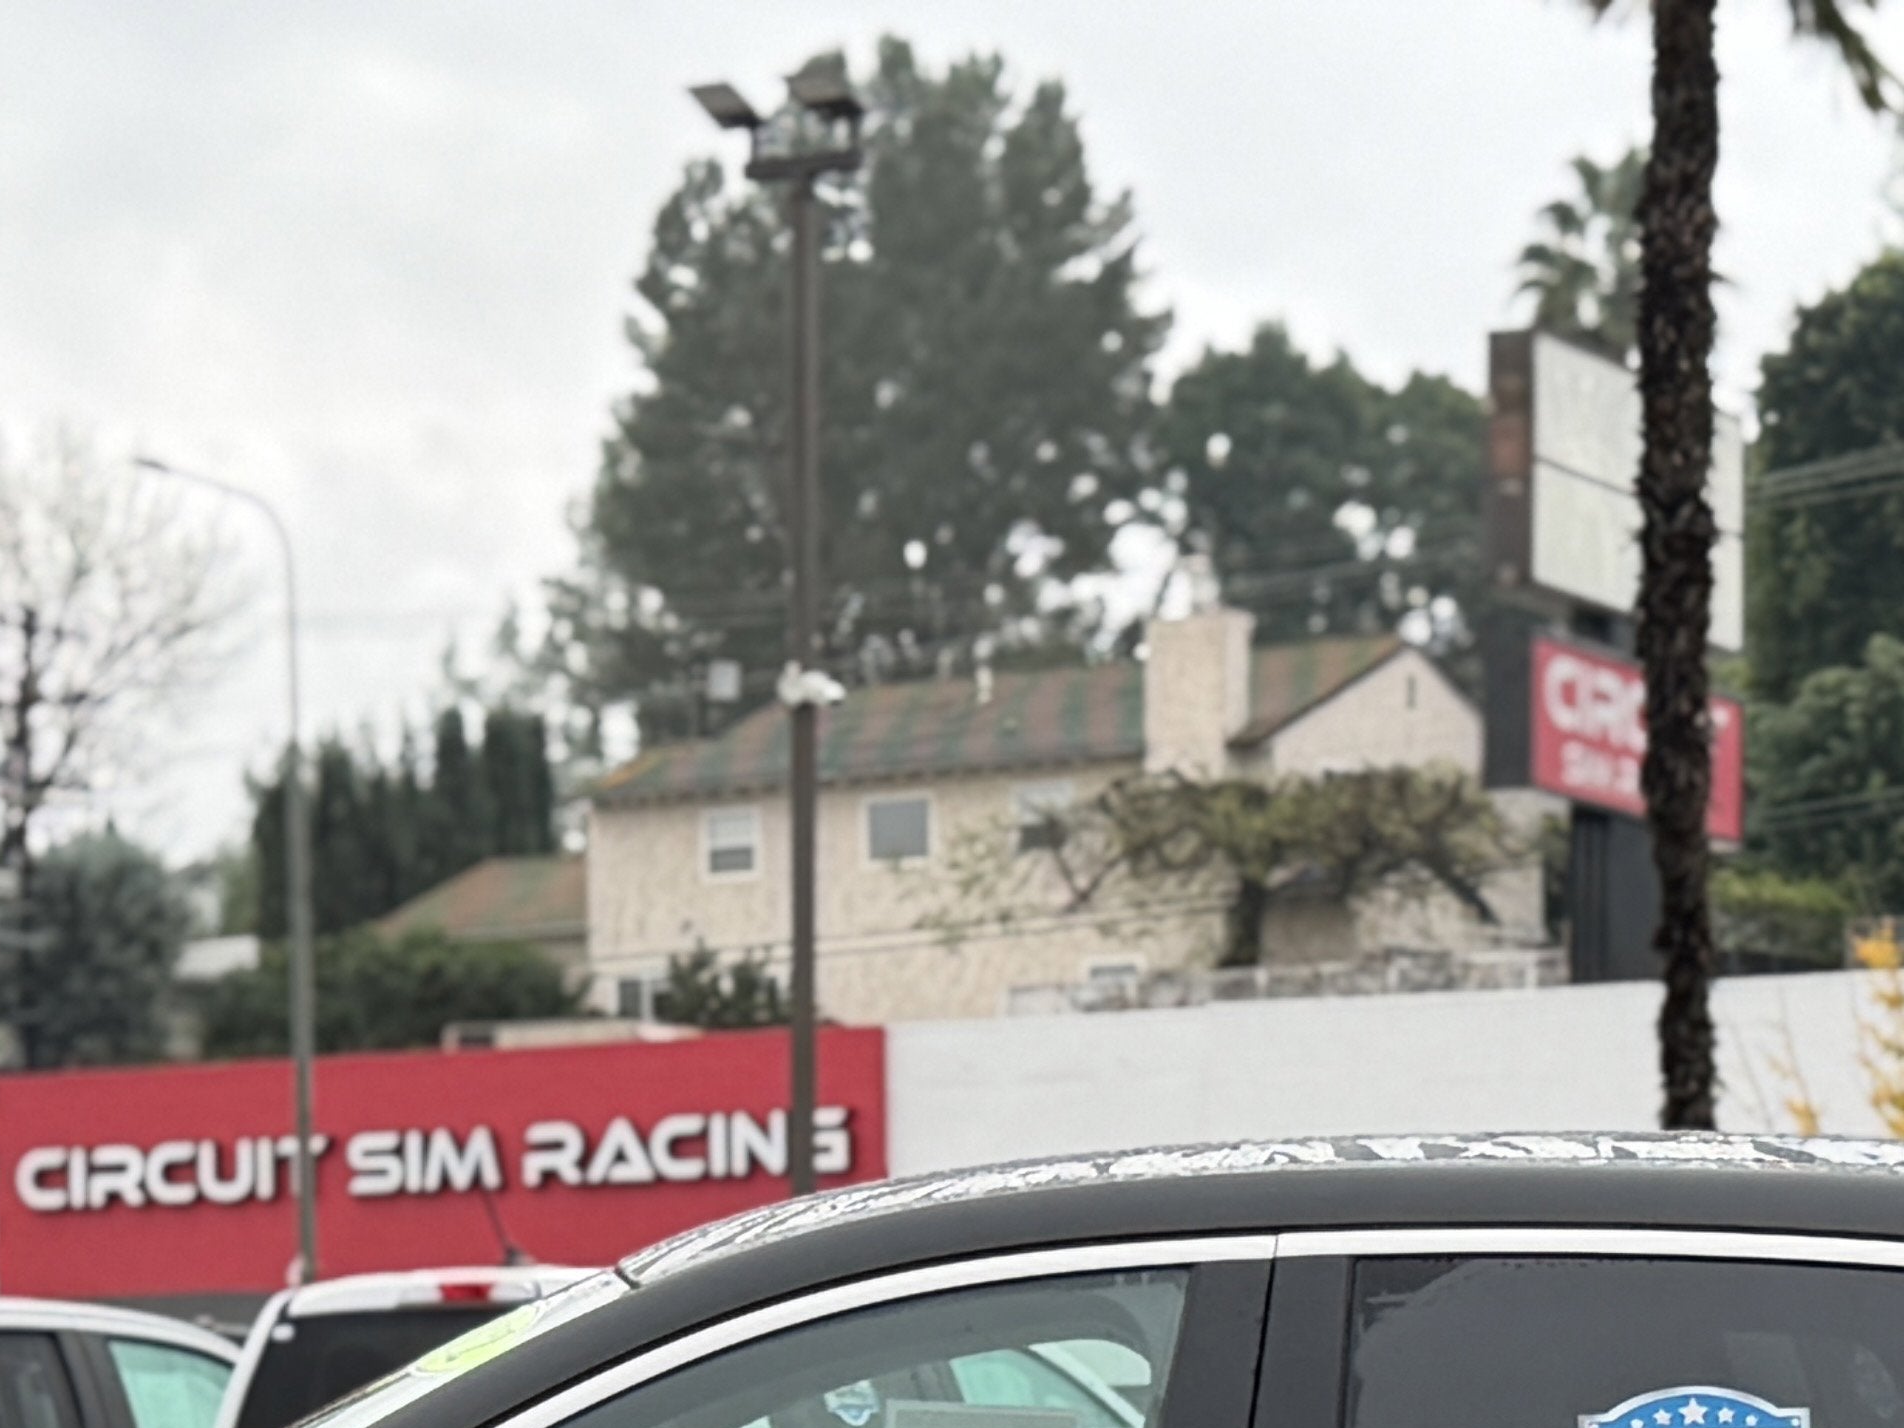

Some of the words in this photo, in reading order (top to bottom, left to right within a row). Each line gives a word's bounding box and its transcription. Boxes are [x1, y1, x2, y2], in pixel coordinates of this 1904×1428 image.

[15, 1134, 329, 1211] CIRCUIT
[346, 1123, 503, 1197] SIM
[521, 1105, 851, 1188] RACING
